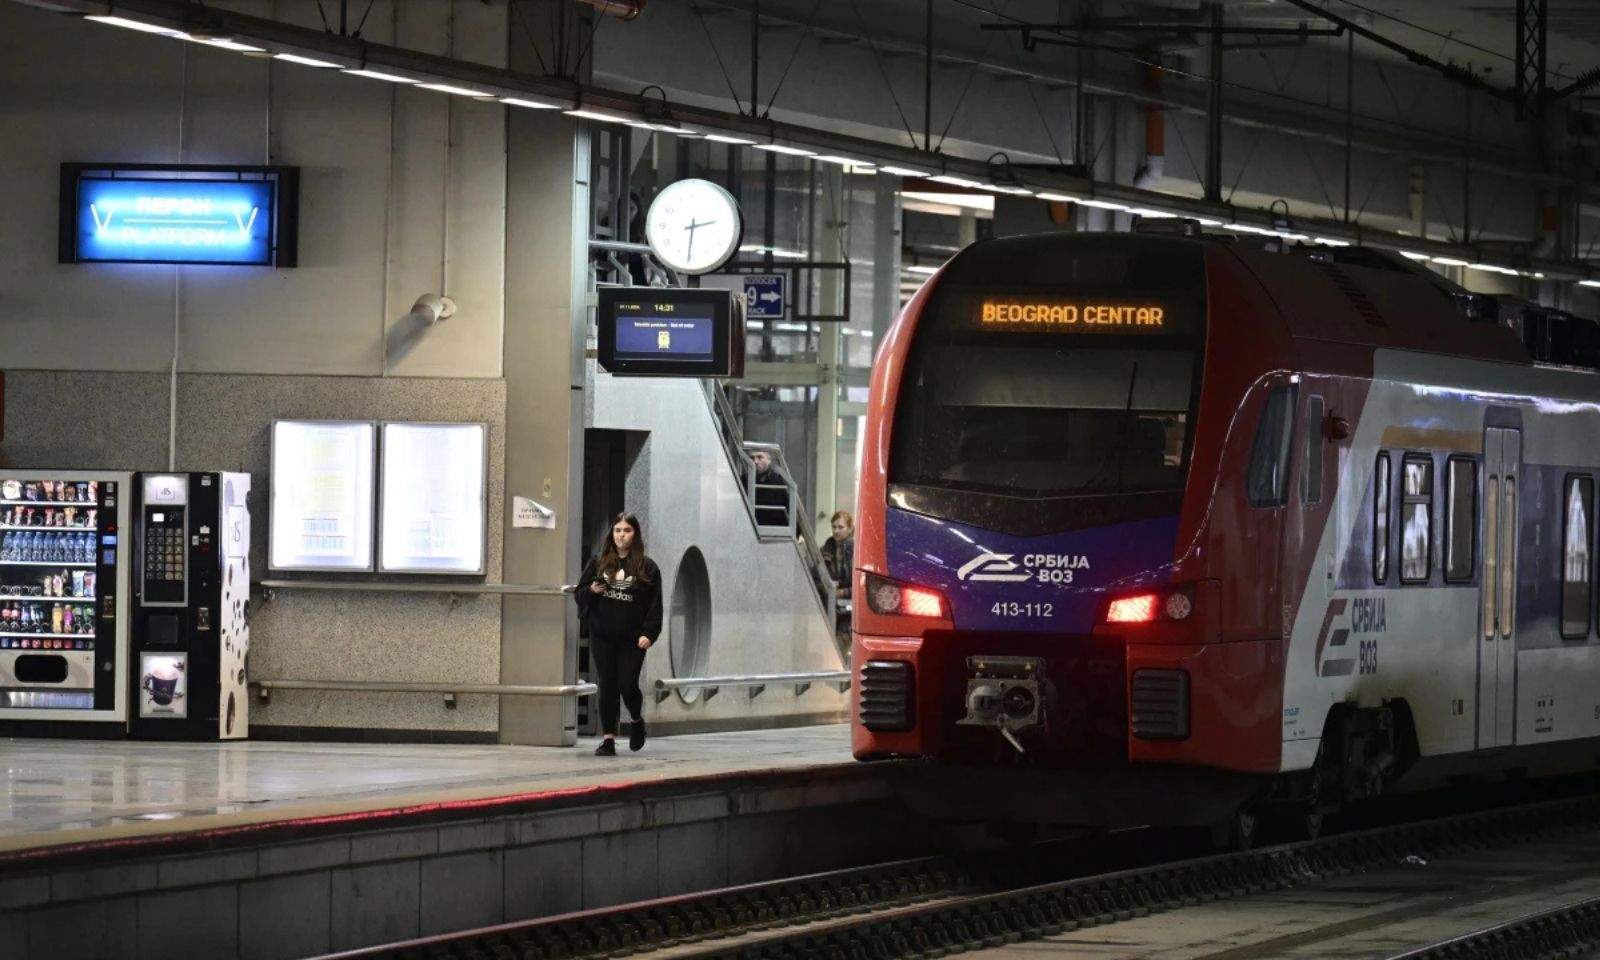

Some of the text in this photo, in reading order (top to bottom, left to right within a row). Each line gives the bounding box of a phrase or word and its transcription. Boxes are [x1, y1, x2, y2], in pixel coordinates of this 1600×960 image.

[135, 197, 210, 215] ПЕРОН
[121, 226, 225, 246] PLATFORM
[747, 286, 757, 306] 9
[654, 304, 674, 312] 14:31
[982, 303, 1164, 325] BEOGRAD CENTAR
[1023, 554, 1090, 569] СРБИЈА
[1038, 569, 1074, 583] ВОЗ
[602, 589, 633, 602] adidas
[991, 602, 1053, 617] 413-112
[1352, 597, 1387, 633] СРБИЈА
[1359, 640, 1377, 675] ВОЗ
